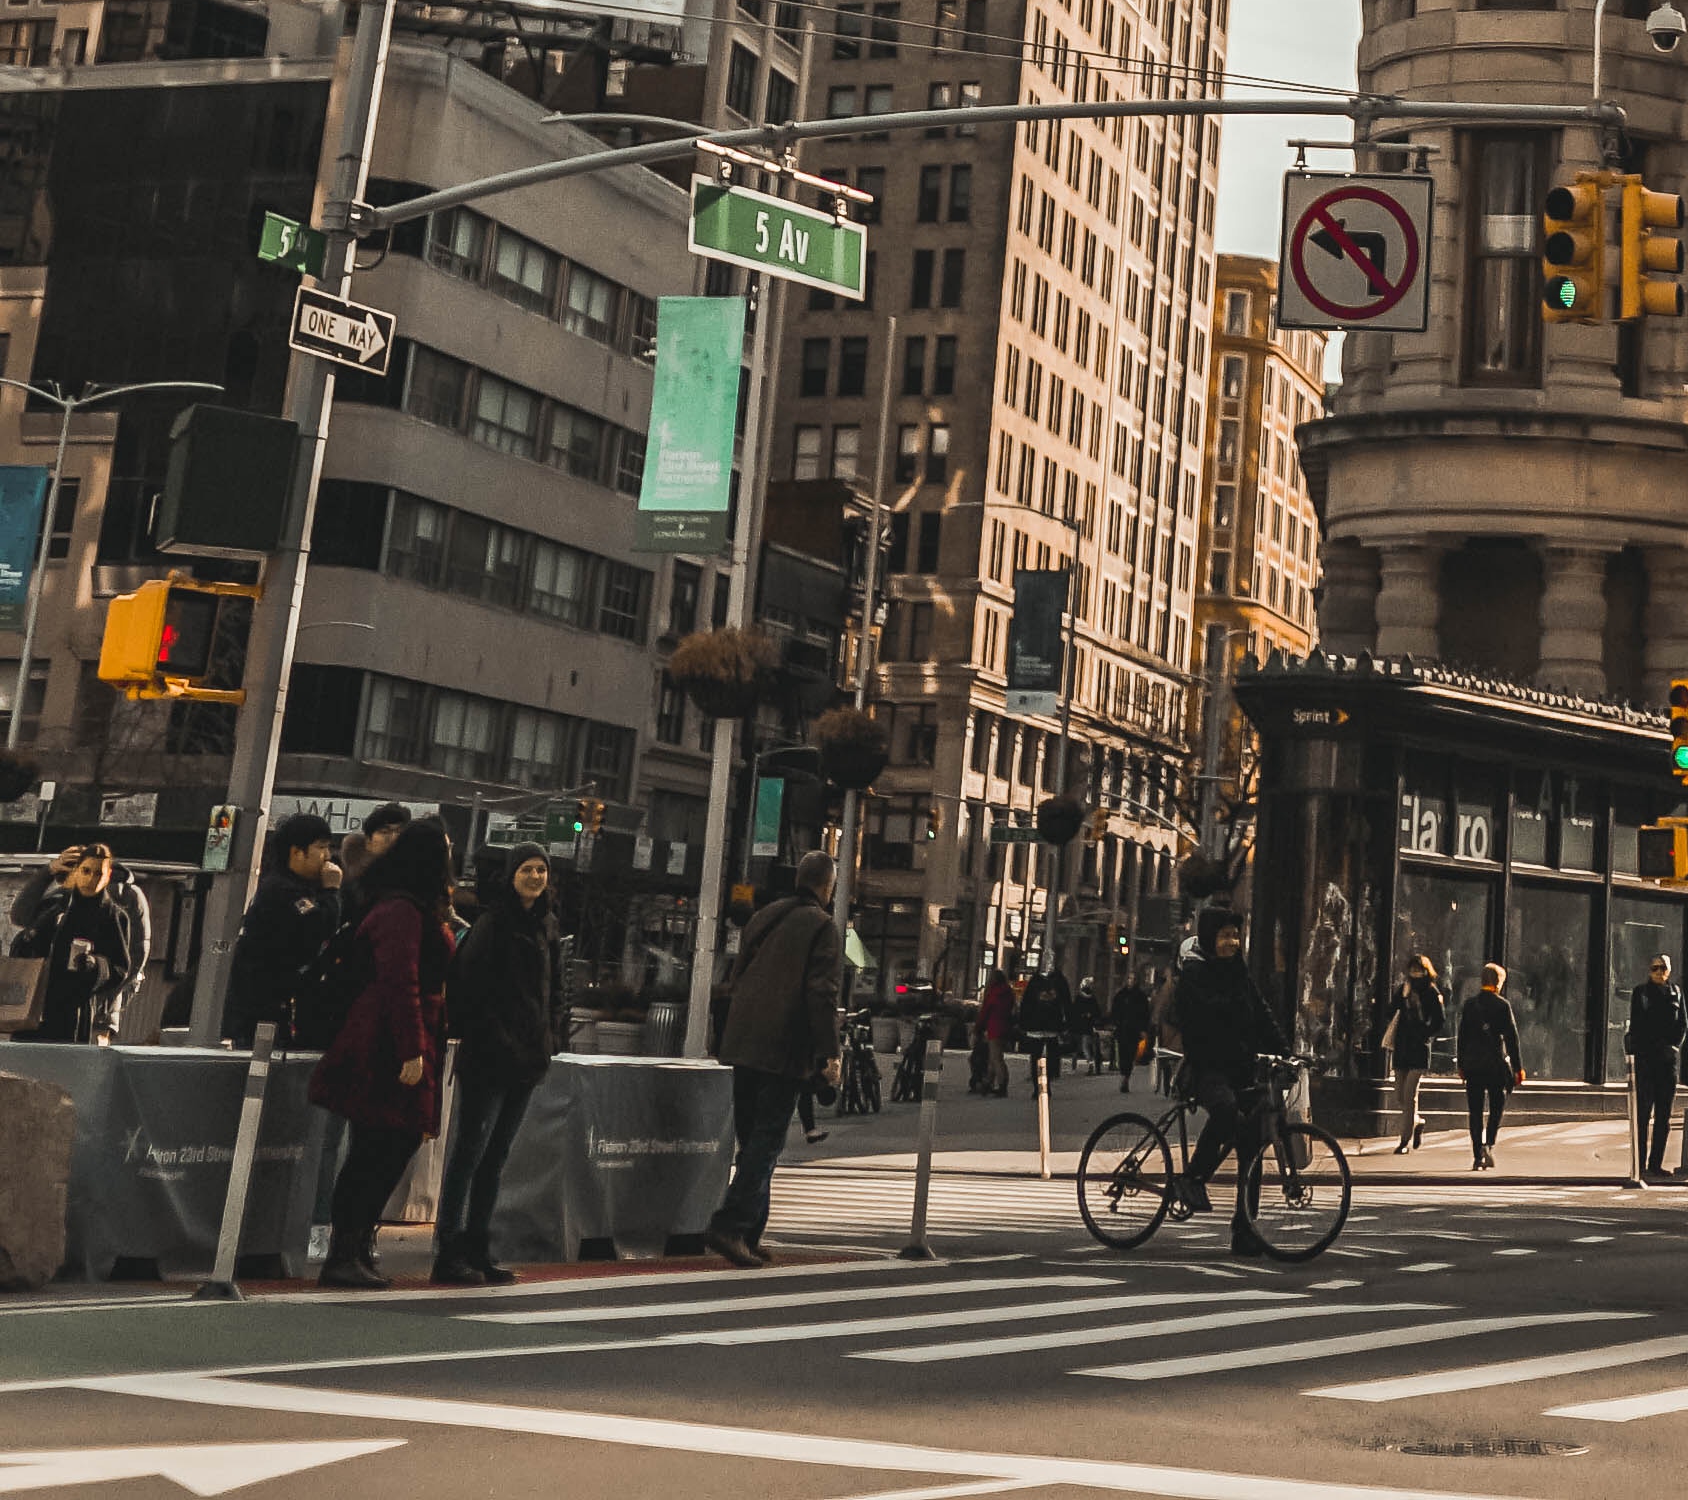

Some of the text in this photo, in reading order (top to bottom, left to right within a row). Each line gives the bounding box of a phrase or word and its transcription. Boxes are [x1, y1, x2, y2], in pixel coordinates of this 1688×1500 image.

[755, 210, 810, 265] 5 Av
[308, 311, 377, 350] ONE WAY
